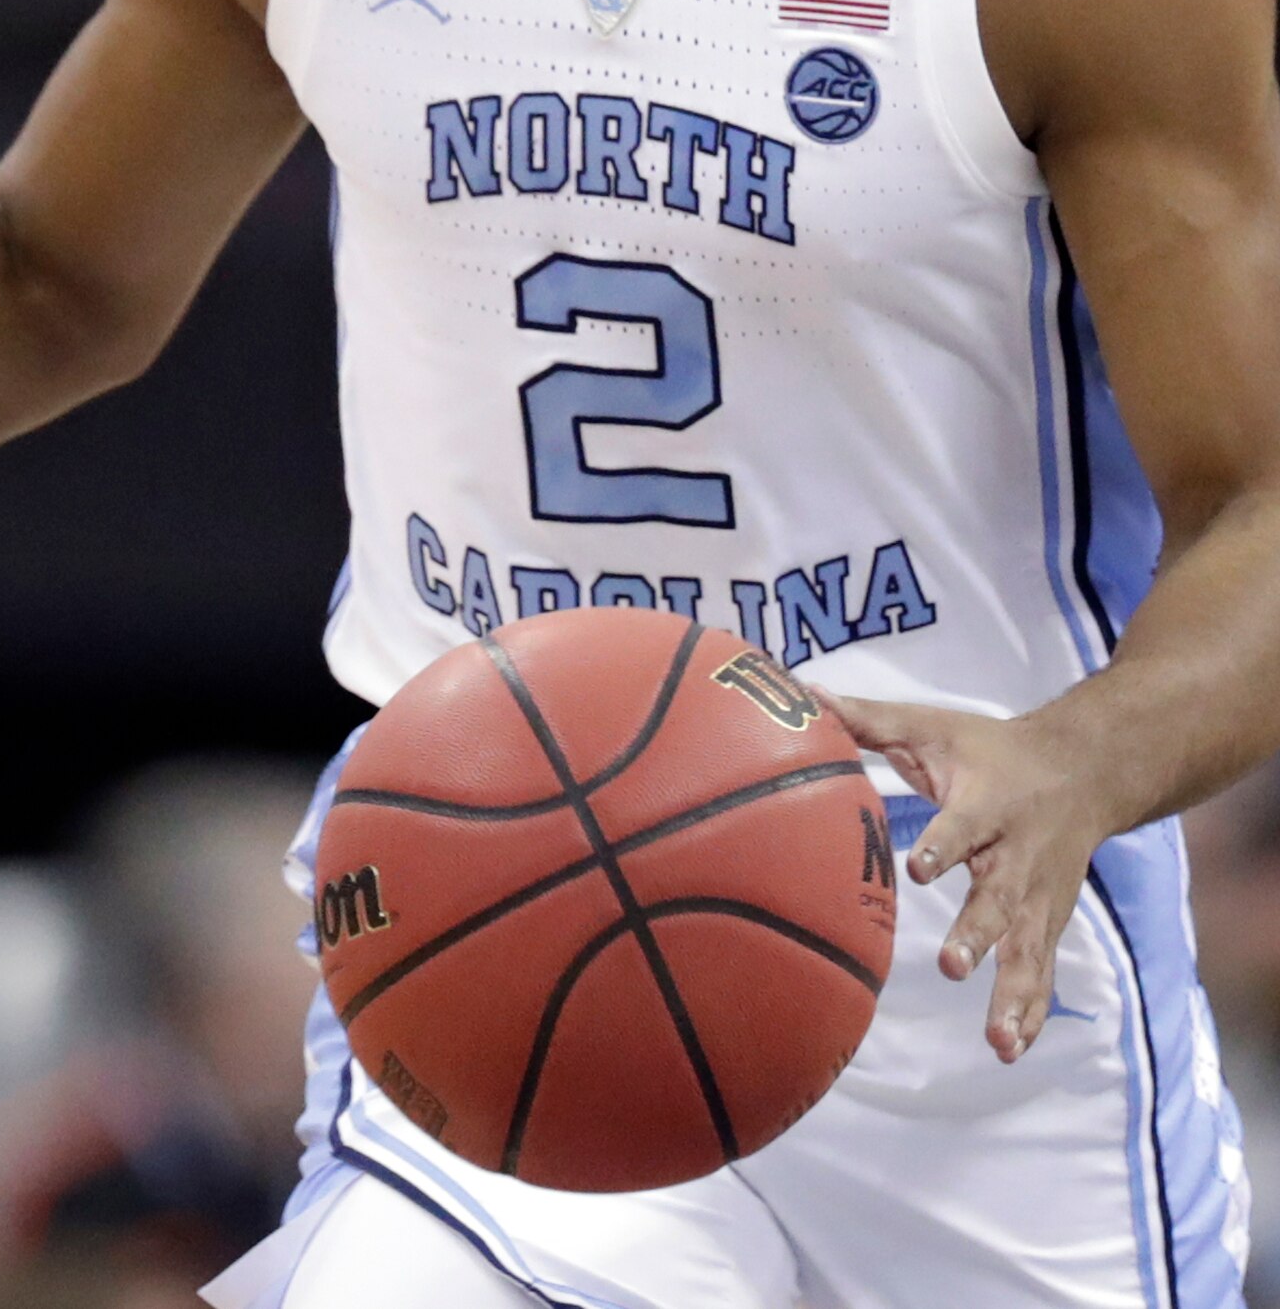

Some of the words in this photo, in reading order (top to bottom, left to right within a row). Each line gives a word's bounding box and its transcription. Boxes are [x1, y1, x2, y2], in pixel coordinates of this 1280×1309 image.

[798, 77, 871, 102] ACC
[425, 92, 795, 246] NORTH
[514, 251, 736, 531] 2
